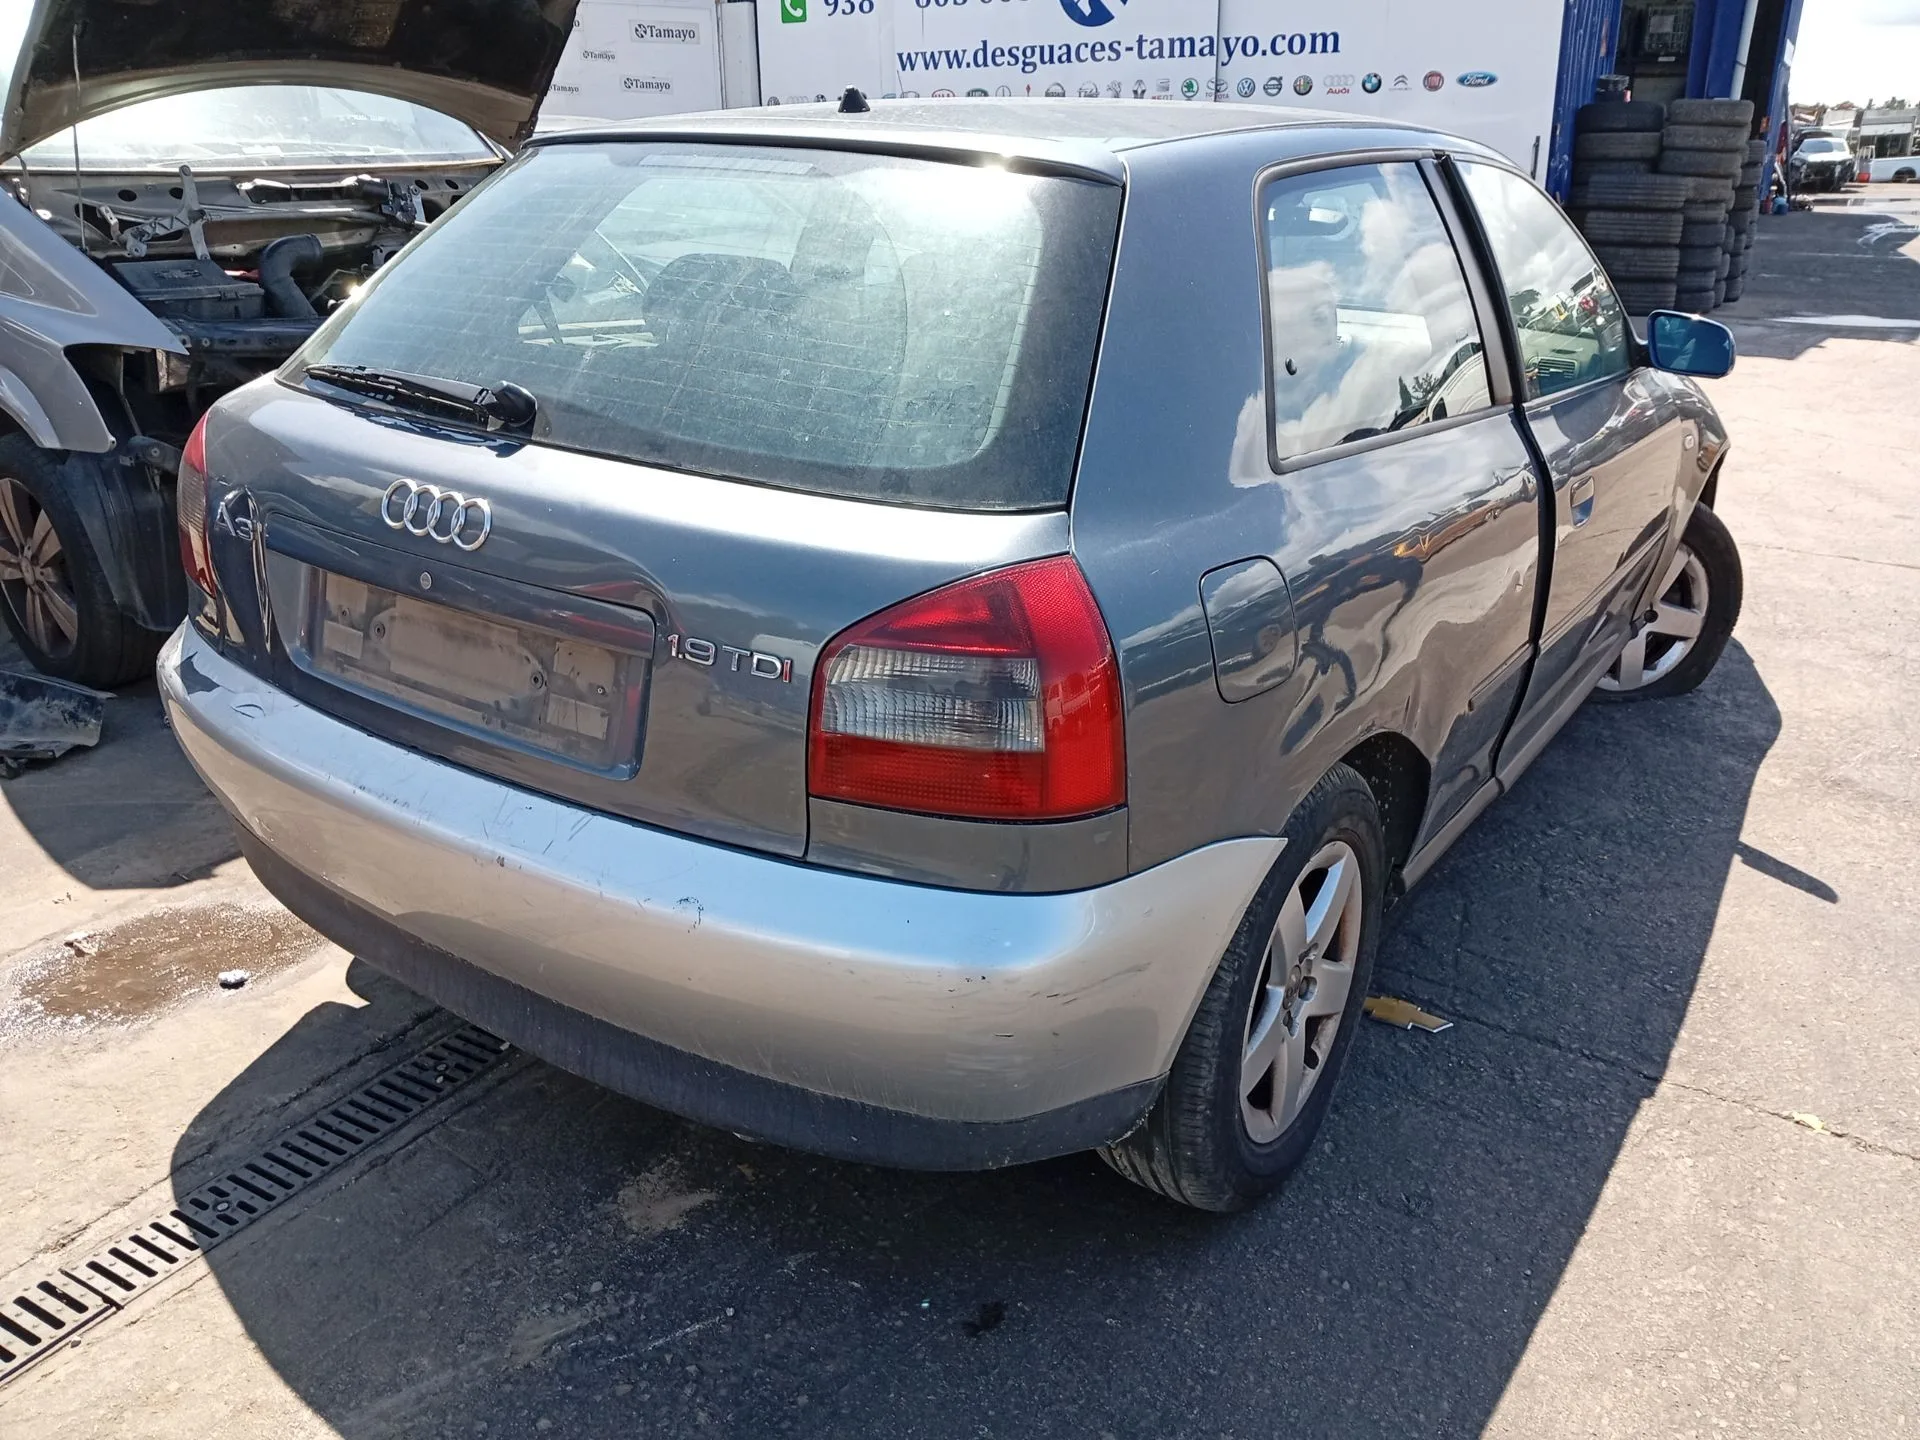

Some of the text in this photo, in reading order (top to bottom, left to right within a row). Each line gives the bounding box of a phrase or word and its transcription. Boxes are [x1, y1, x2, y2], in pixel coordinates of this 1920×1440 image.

[647, 25, 696, 42] Tamayo
[590, 51, 616, 61] Tamayo
[896, 31, 1340, 74] www.desguaces-tamayo.com
[552, 84, 579, 94] Tamayo
[633, 78, 671, 91] Tamayo
[215, 502, 254, 541] A3
[667, 634, 717, 666] 1.9
